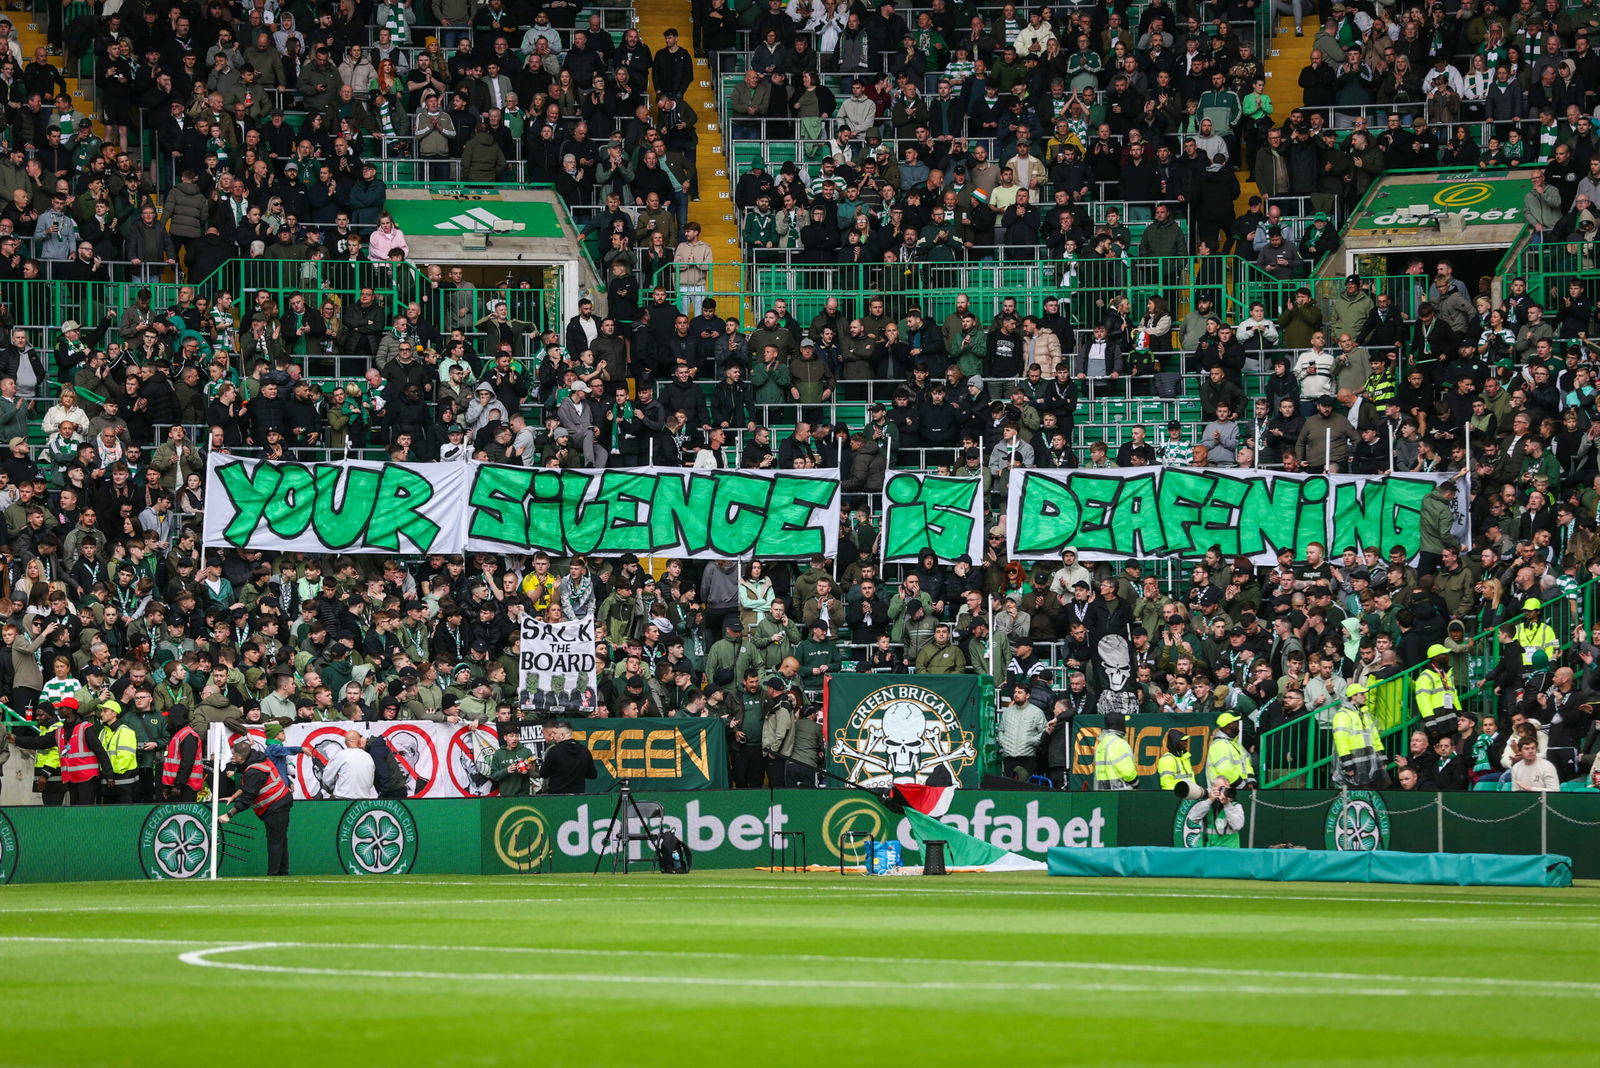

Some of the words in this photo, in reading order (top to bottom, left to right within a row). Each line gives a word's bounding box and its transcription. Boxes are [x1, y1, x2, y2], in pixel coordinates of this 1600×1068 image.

[214, 459, 442, 555] YOUR
[522, 617, 592, 643] SACK
[549, 643, 570, 653] THE
[521, 651, 595, 673] BOARD
[851, 687, 897, 729] GREEN
[898, 686, 959, 731] BRIGADE
[572, 726, 710, 780] REEN
[143, 829, 154, 848] THE
[149, 805, 172, 829] CELTIC
[341, 825, 351, 842] THE
[347, 801, 369, 824] CELTIC
[402, 818, 415, 842] CLUB
